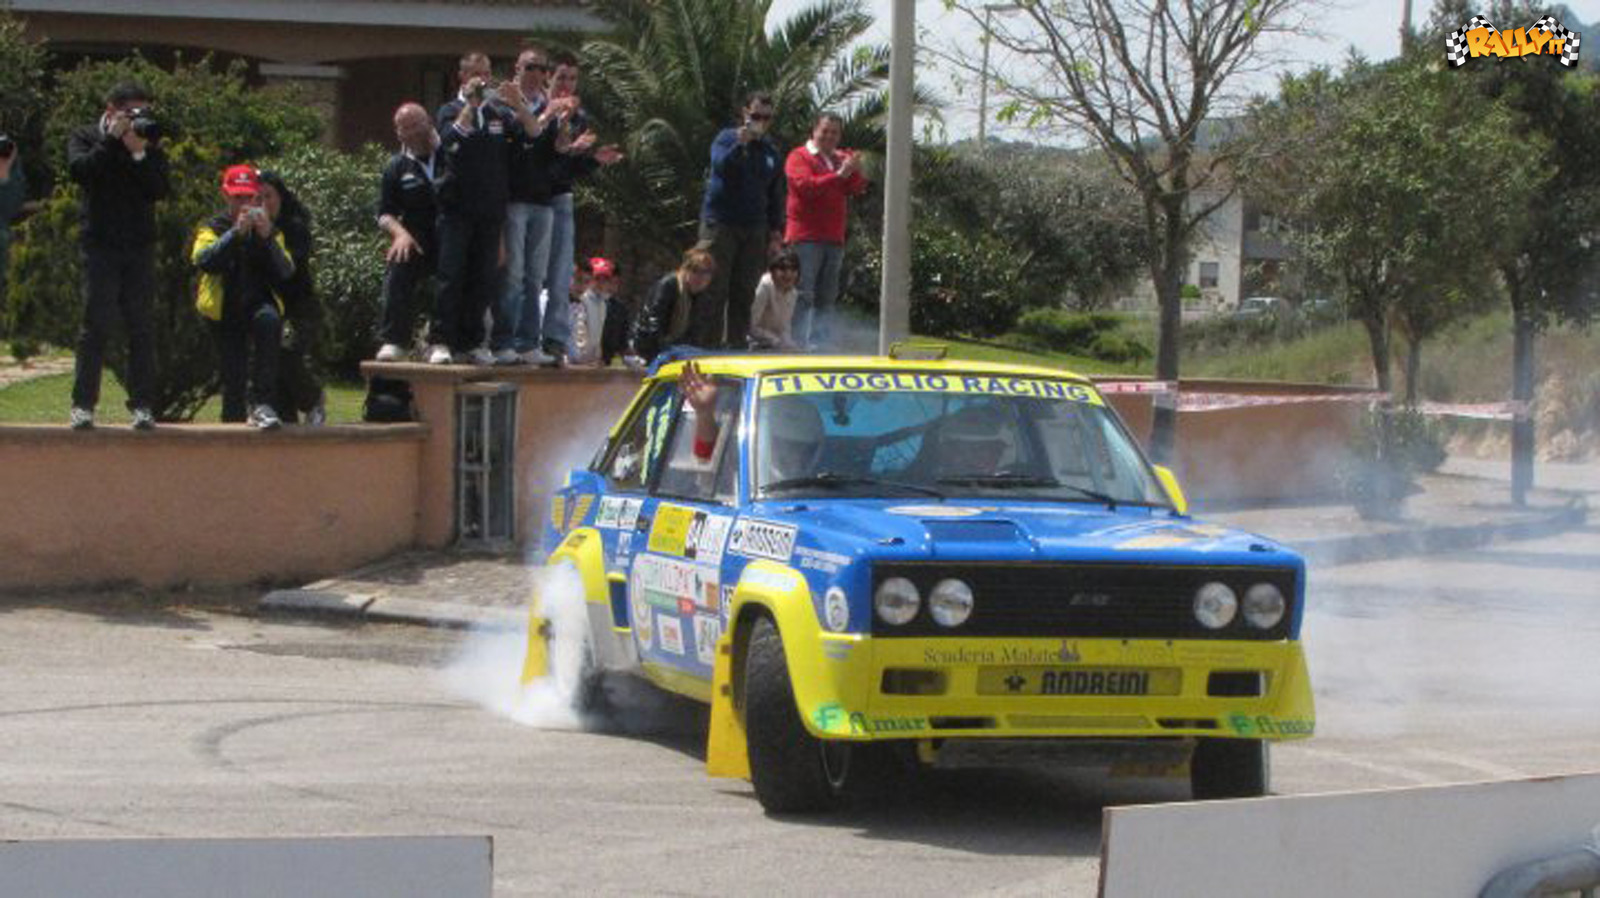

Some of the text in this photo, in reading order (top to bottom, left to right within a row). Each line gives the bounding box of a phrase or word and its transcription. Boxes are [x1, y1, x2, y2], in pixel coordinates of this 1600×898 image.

[767, 374, 1091, 401] TI VOGLIO RACING
[923, 645, 996, 664] Scuderia
[1040, 669, 1151, 696] ANDREINI
